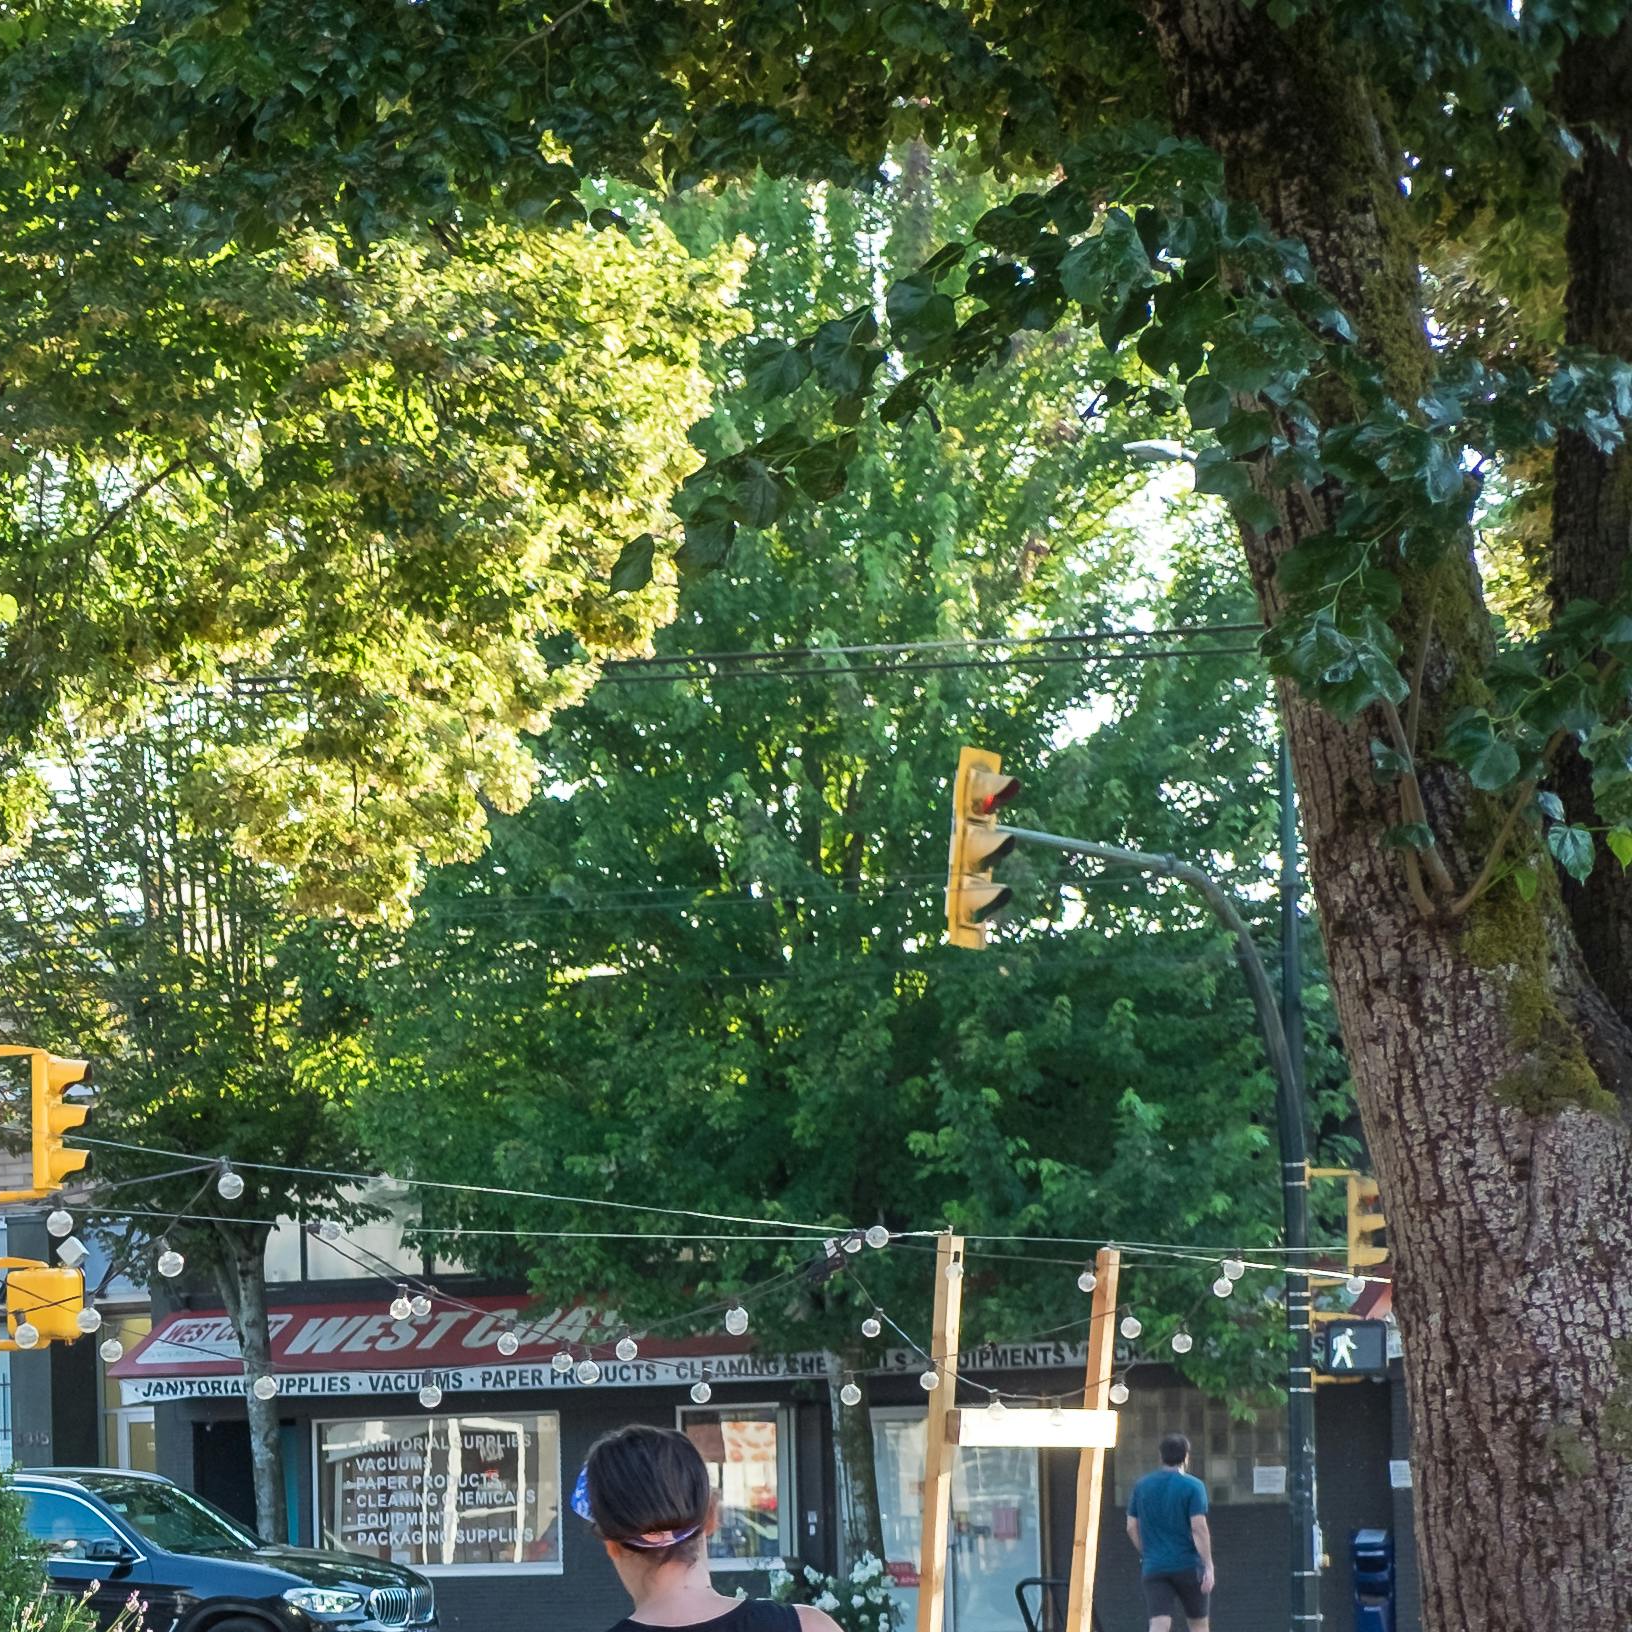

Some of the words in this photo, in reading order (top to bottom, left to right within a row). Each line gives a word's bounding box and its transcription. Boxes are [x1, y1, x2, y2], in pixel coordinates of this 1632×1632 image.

[166, 1322, 222, 1342] WEST
[283, 1310, 471, 1355] WEST
[481, 1370, 542, 1388] PAPER
[356, 1456, 433, 1472] VACUUMS
[356, 1475, 408, 1490] PAPER
[356, 1492, 438, 1508] CLEANING
